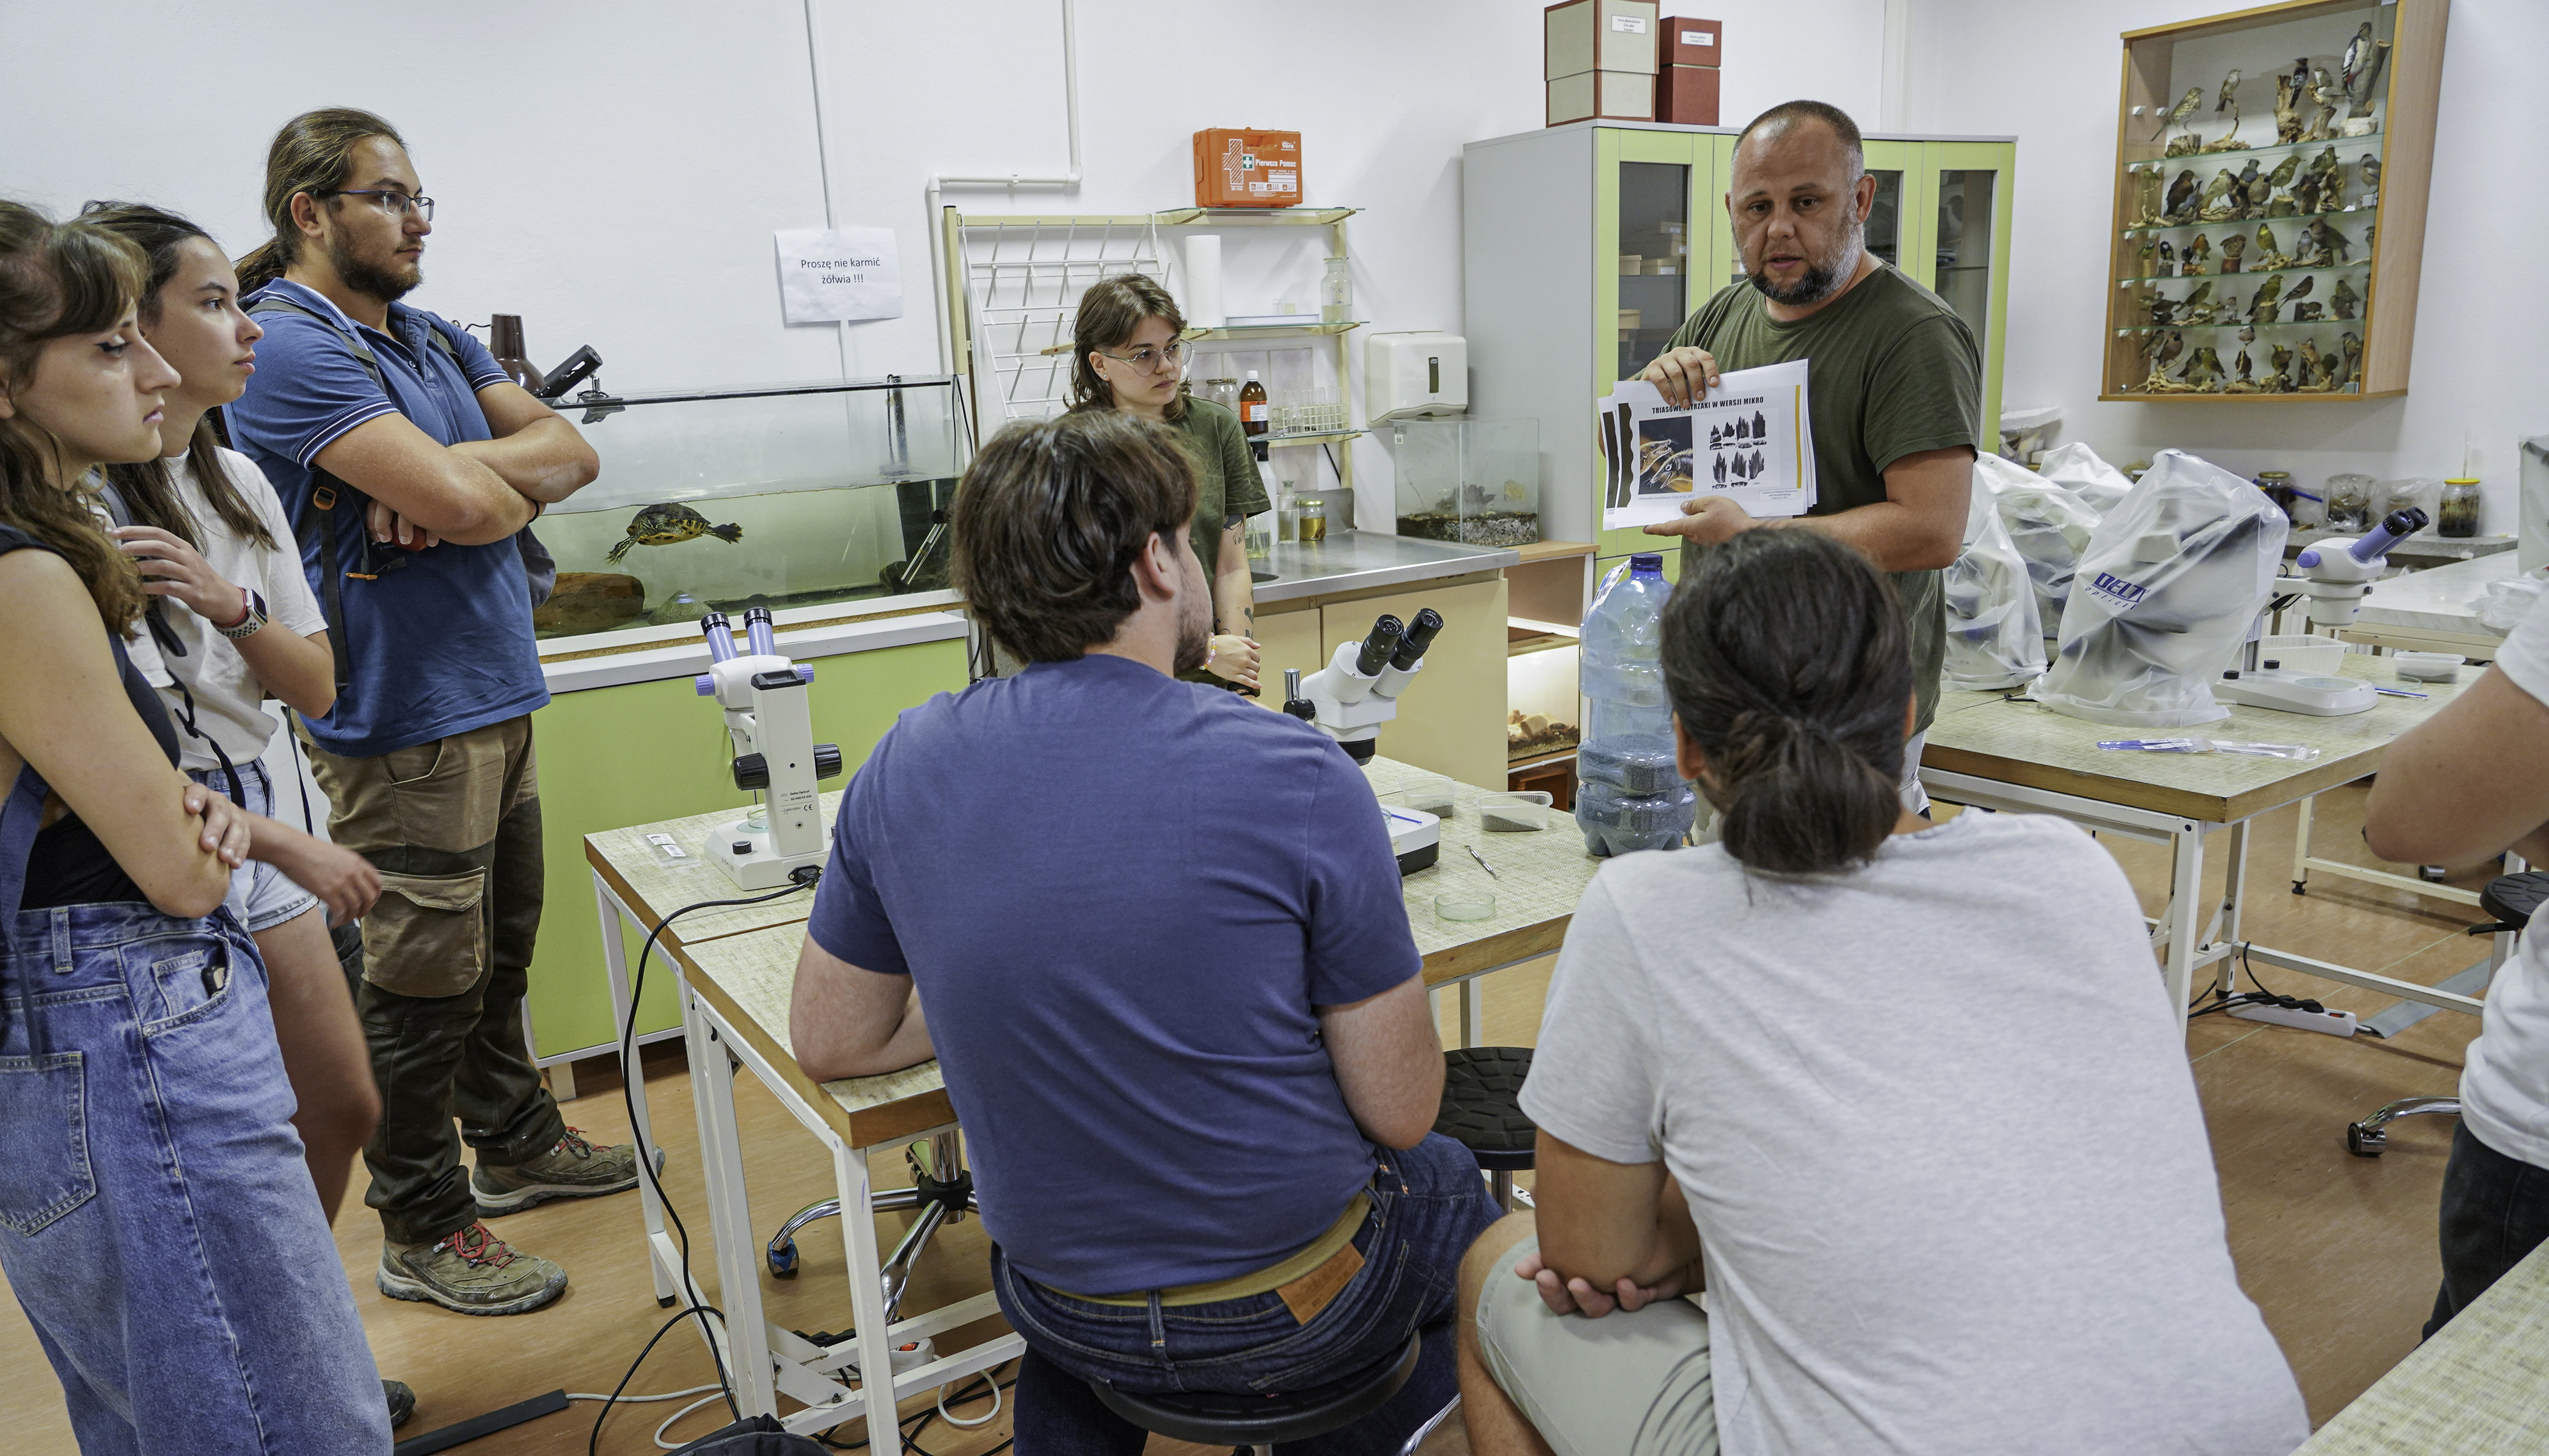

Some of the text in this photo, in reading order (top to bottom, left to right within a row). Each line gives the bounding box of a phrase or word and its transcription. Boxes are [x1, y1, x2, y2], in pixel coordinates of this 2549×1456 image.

[801, 257, 880, 270] Proszę nie karmić
[822, 274, 864, 284] żółwia !!!
[2084, 587, 2138, 610] optical
